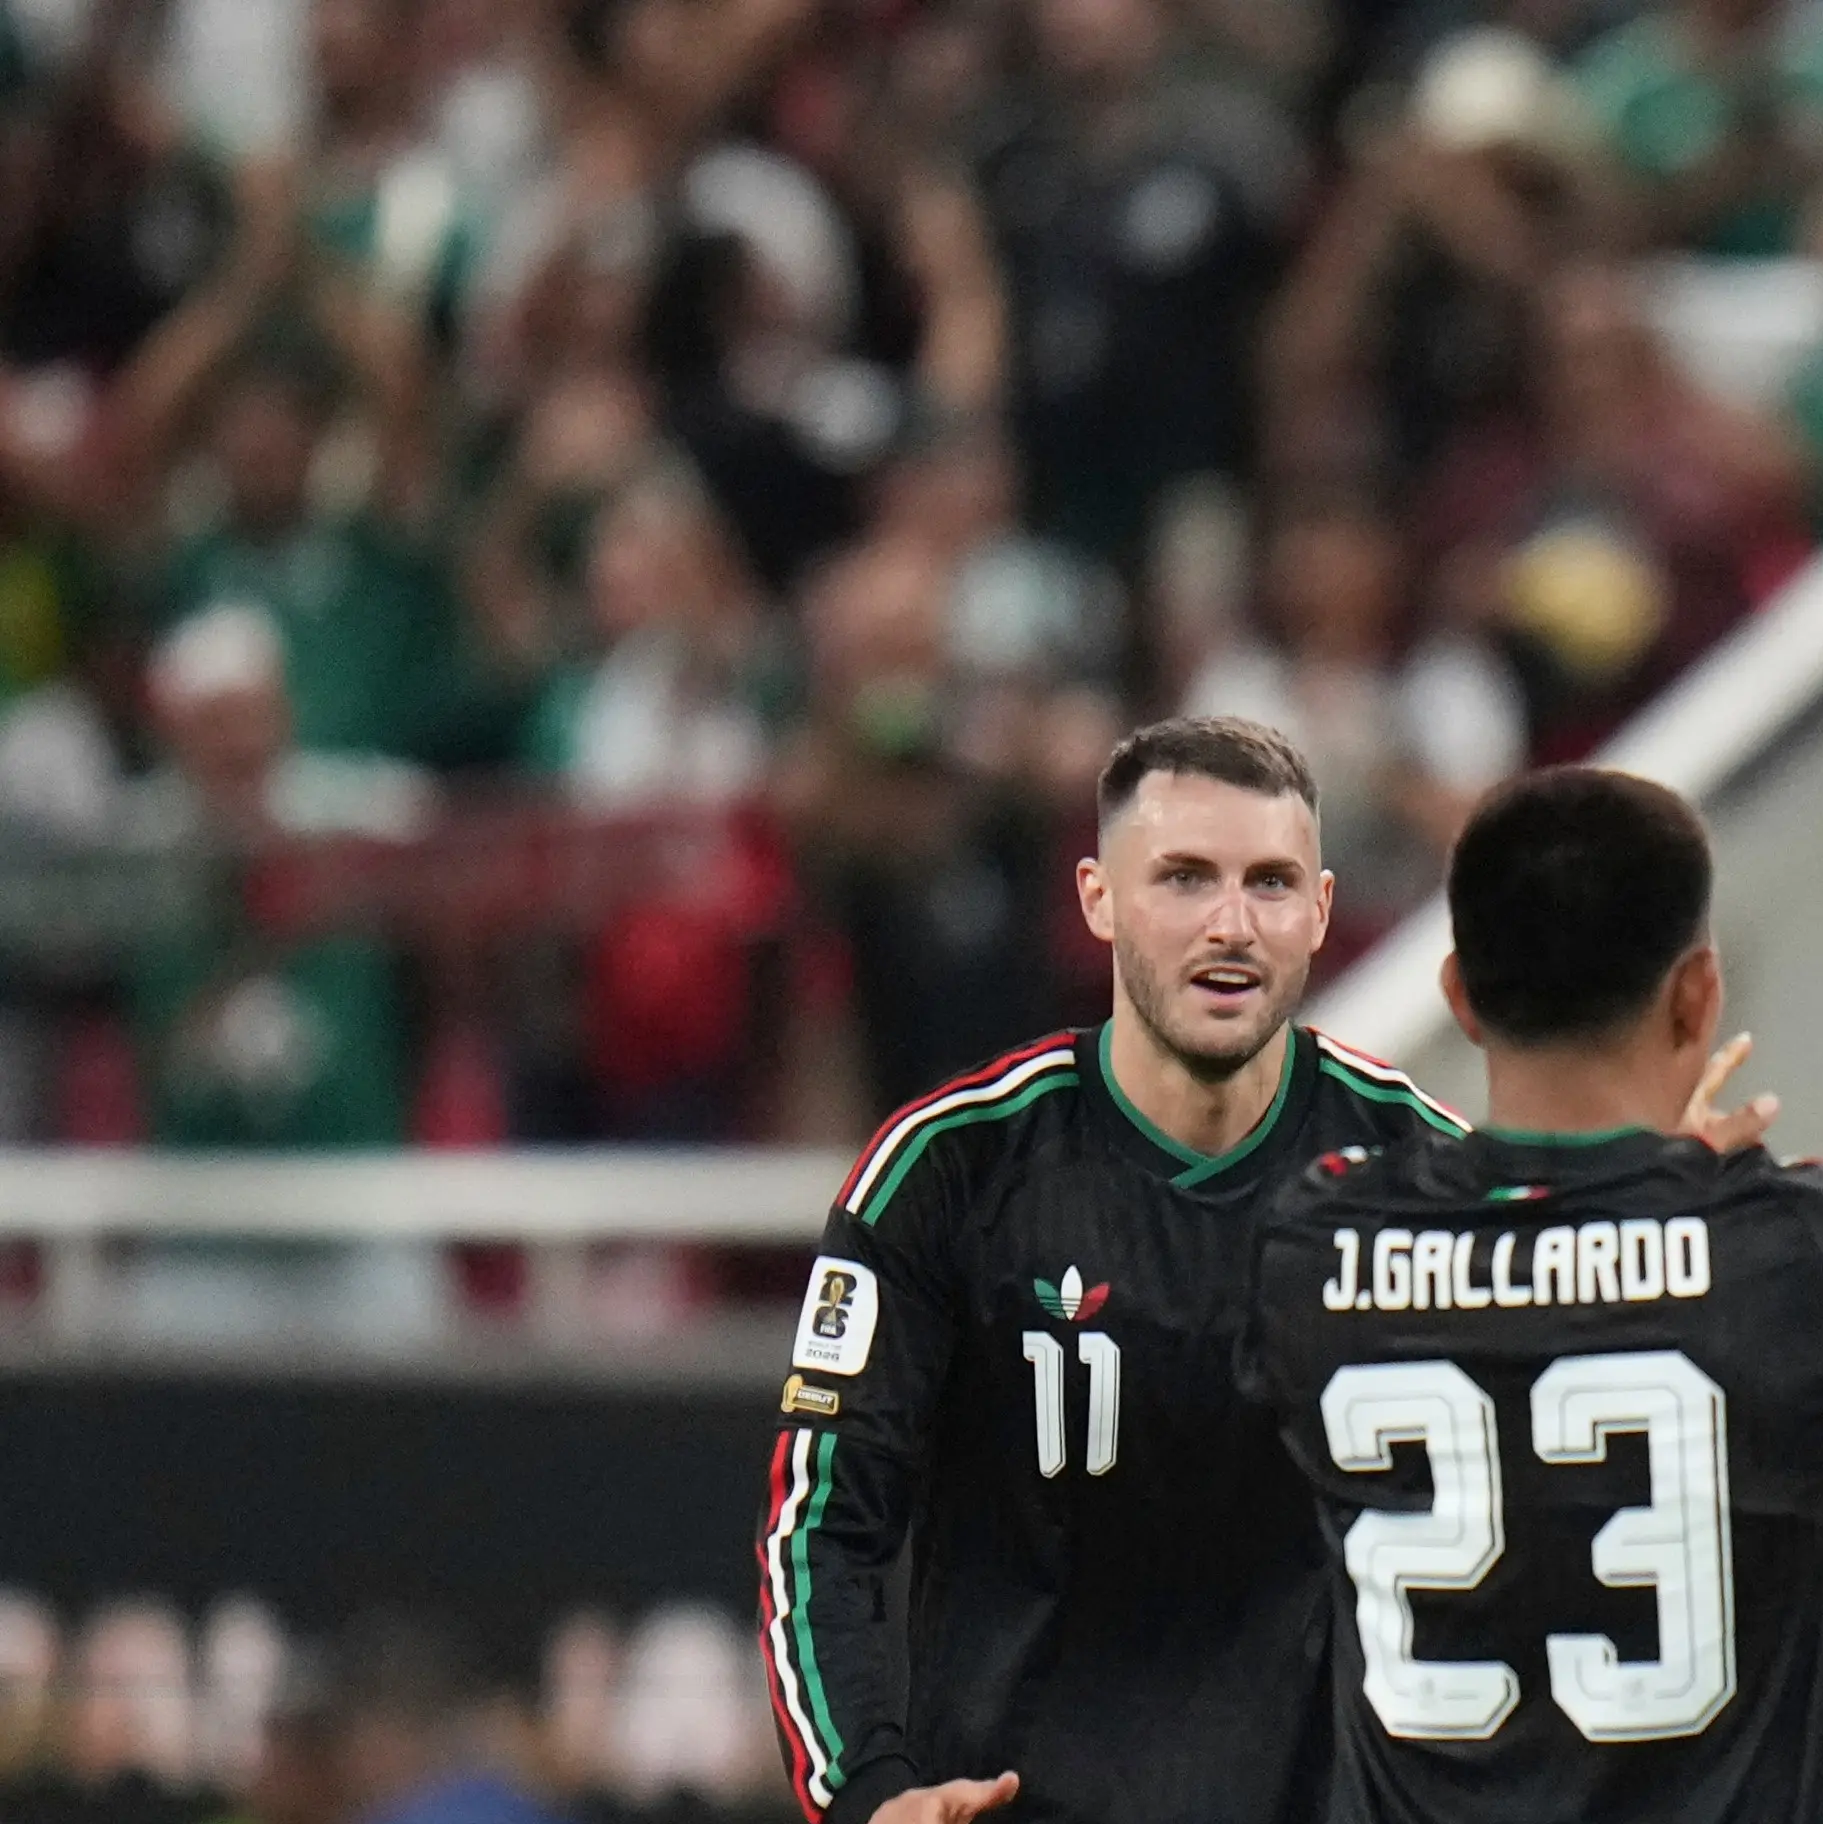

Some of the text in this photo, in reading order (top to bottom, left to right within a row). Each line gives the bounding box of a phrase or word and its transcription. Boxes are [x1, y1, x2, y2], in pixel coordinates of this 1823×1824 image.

[1323, 1216, 1711, 1311] J.GALLARDO
[1022, 1331, 1121, 1479] 11
[1320, 1350, 1737, 1742] 23
